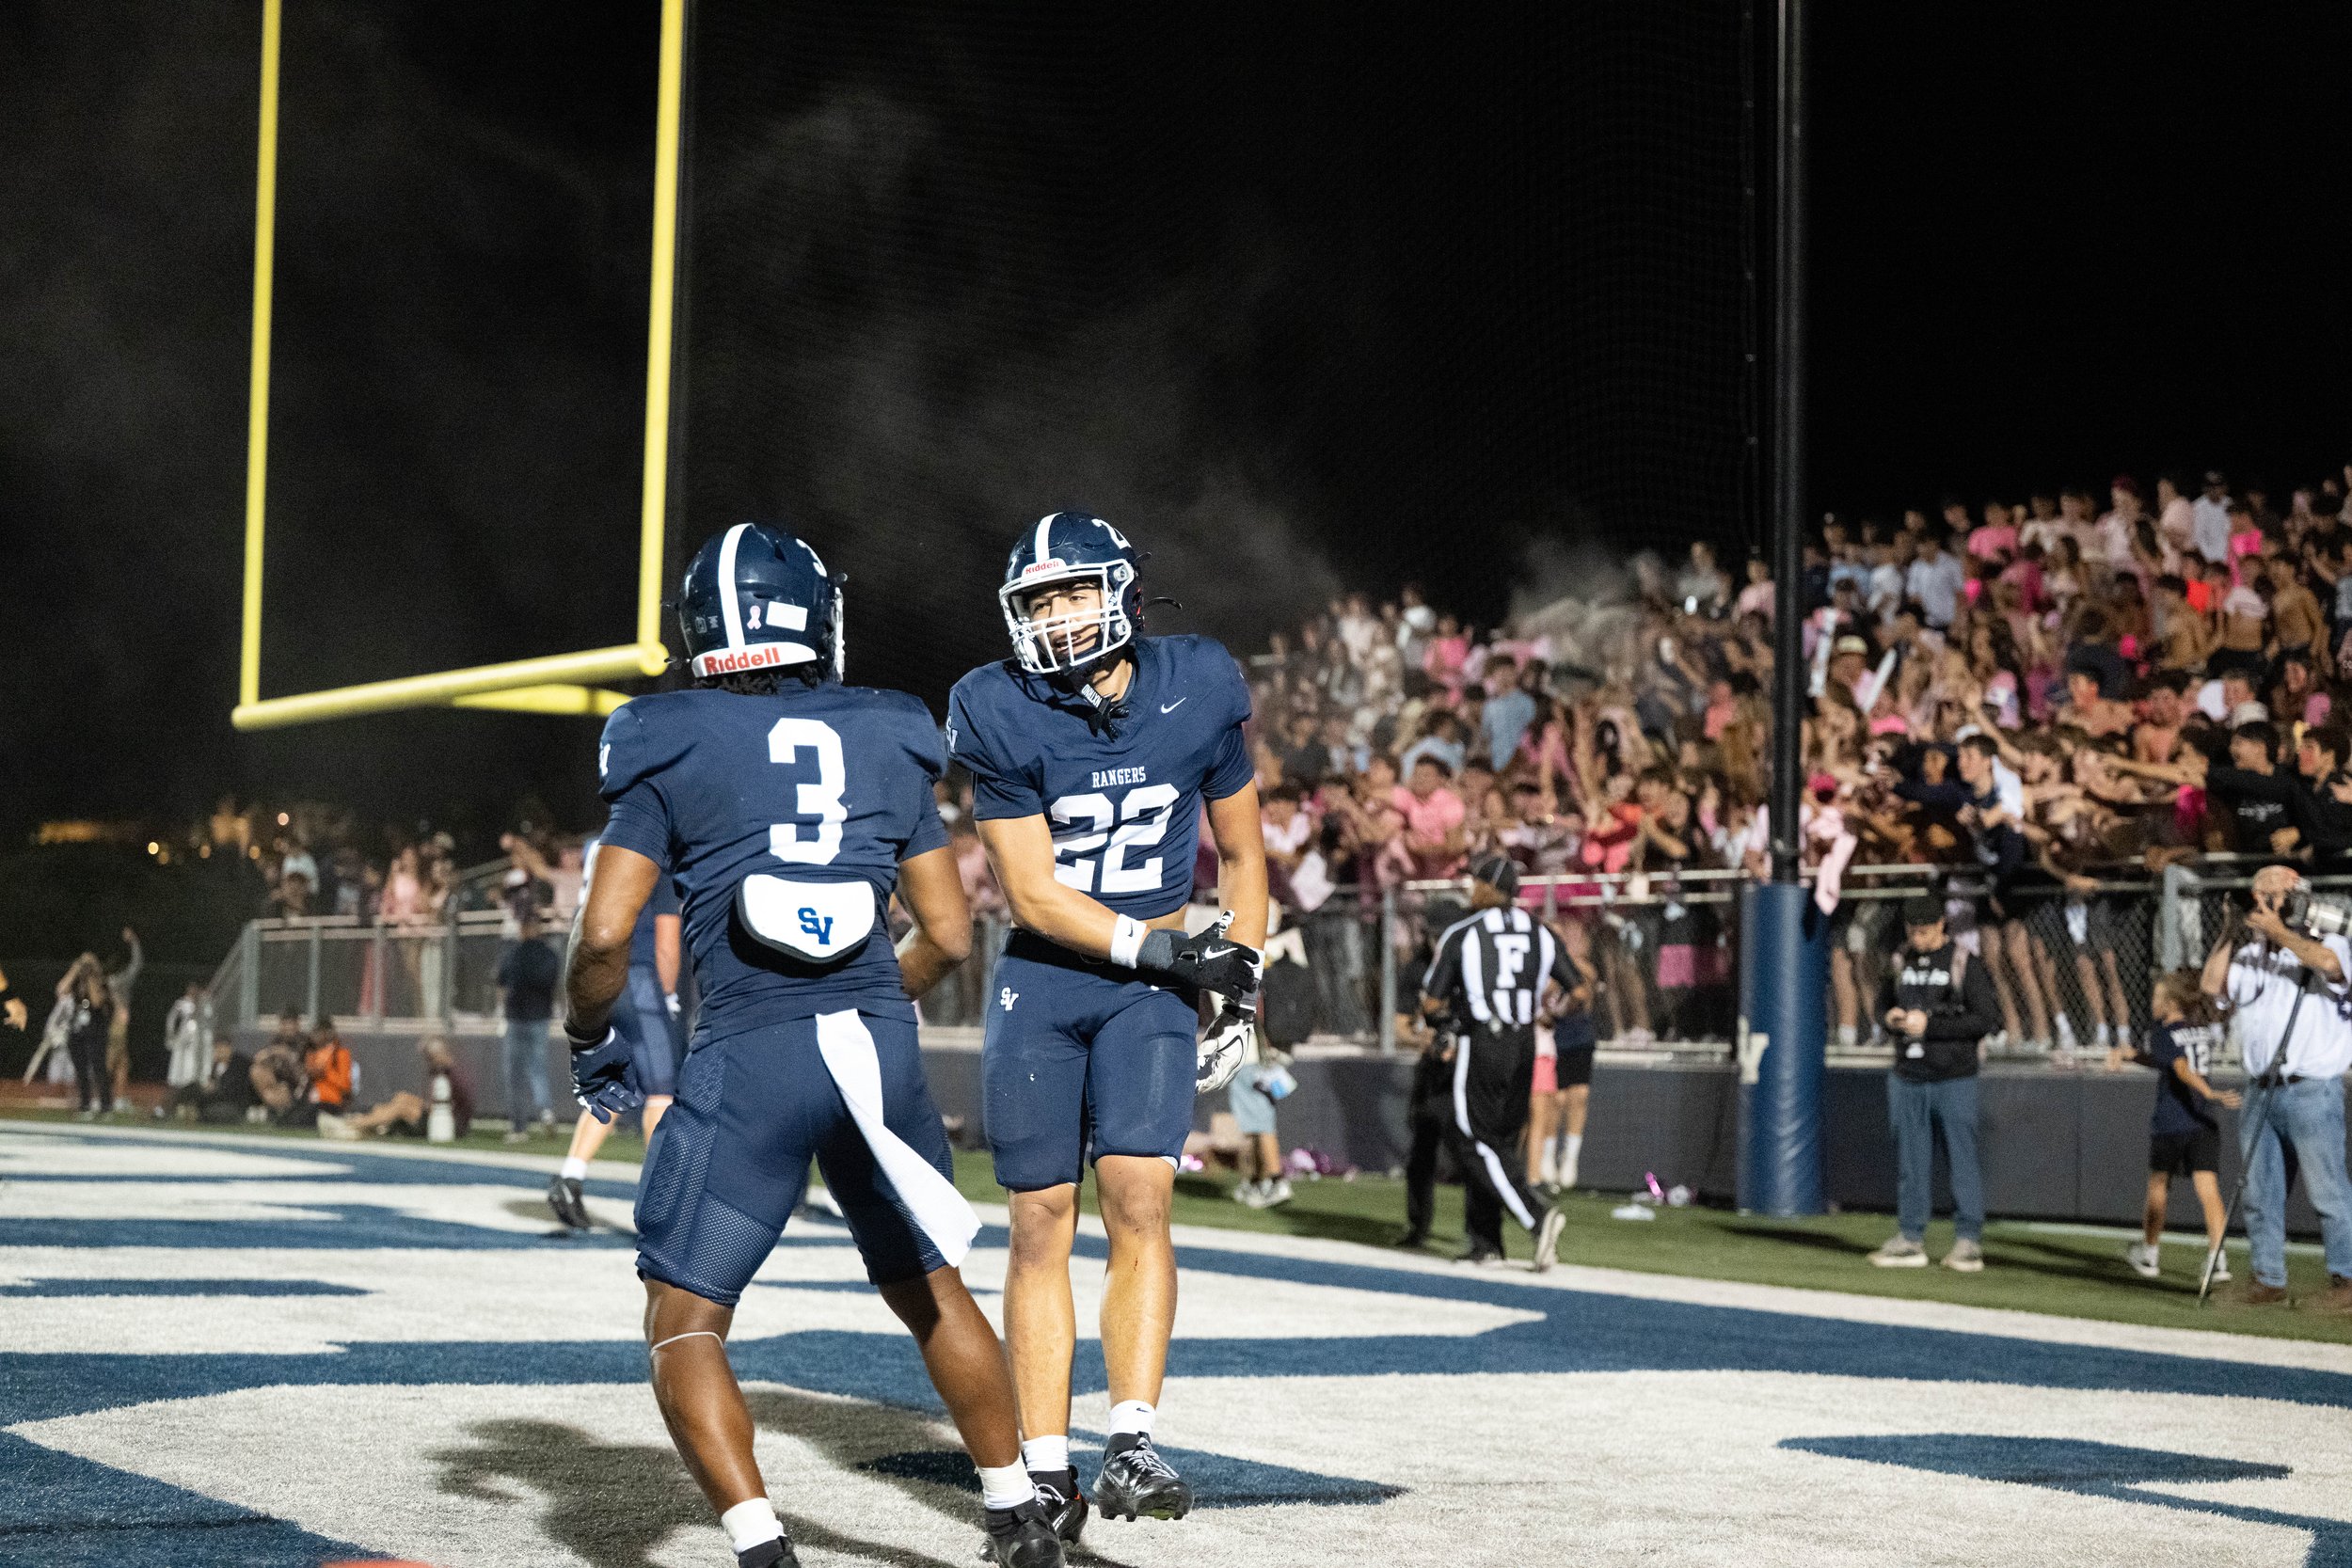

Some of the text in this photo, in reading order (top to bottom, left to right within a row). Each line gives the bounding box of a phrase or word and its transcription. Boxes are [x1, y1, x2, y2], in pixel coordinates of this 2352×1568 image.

[1025, 561, 1059, 575] Riddell
[703, 647, 781, 675] Riddell
[768, 718, 848, 865] 3
[1091, 766, 1146, 788] RANGERS
[1050, 783, 1180, 893] 22
[798, 907, 834, 945] SV
[1493, 933, 1531, 990] F
[1000, 987, 1020, 1011] SV
